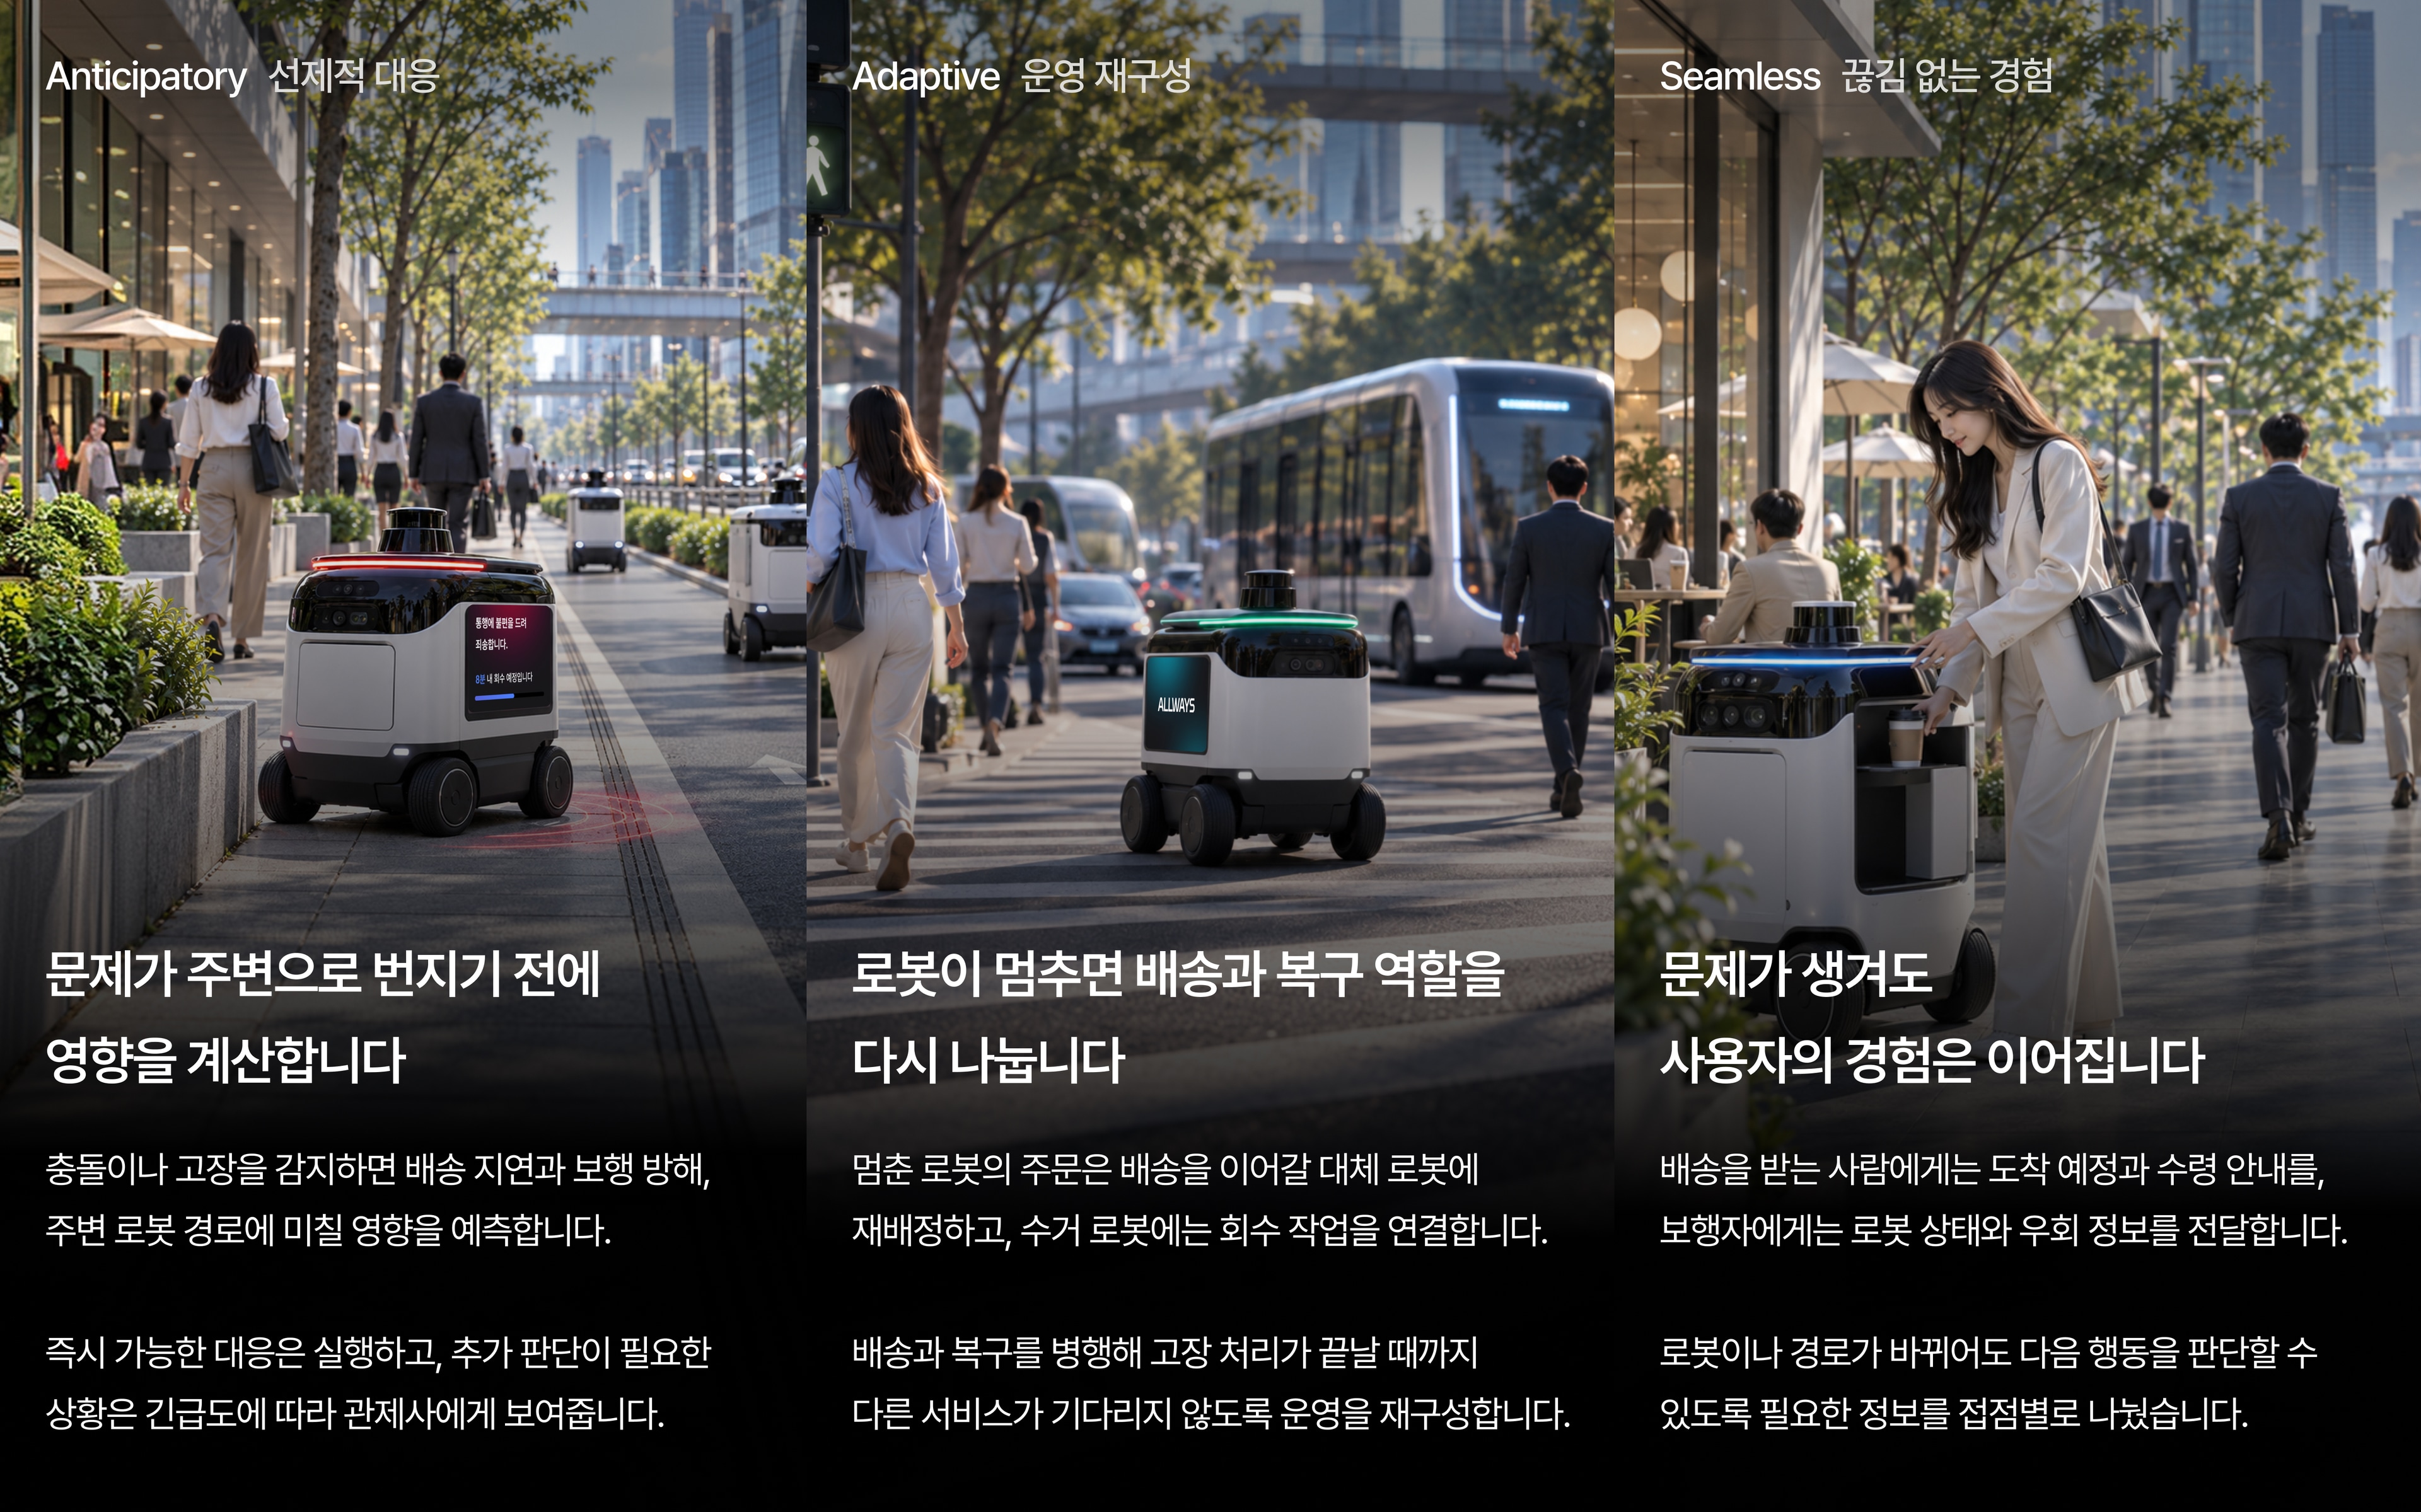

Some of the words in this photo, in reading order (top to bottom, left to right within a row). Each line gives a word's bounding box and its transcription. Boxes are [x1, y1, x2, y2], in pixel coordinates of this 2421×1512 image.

[475, 617, 494, 629] 통행에
[495, 617, 514, 629] 불편을
[514, 617, 526, 629] 드려
[475, 638, 508, 651] 죄송합니다.
[475, 674, 485, 684] 8분
[487, 673, 492, 684] 내
[494, 672, 505, 684] 회수
[506, 671, 533, 683] 예정입니다
[1158, 696, 1195, 713] ALLWAYS
